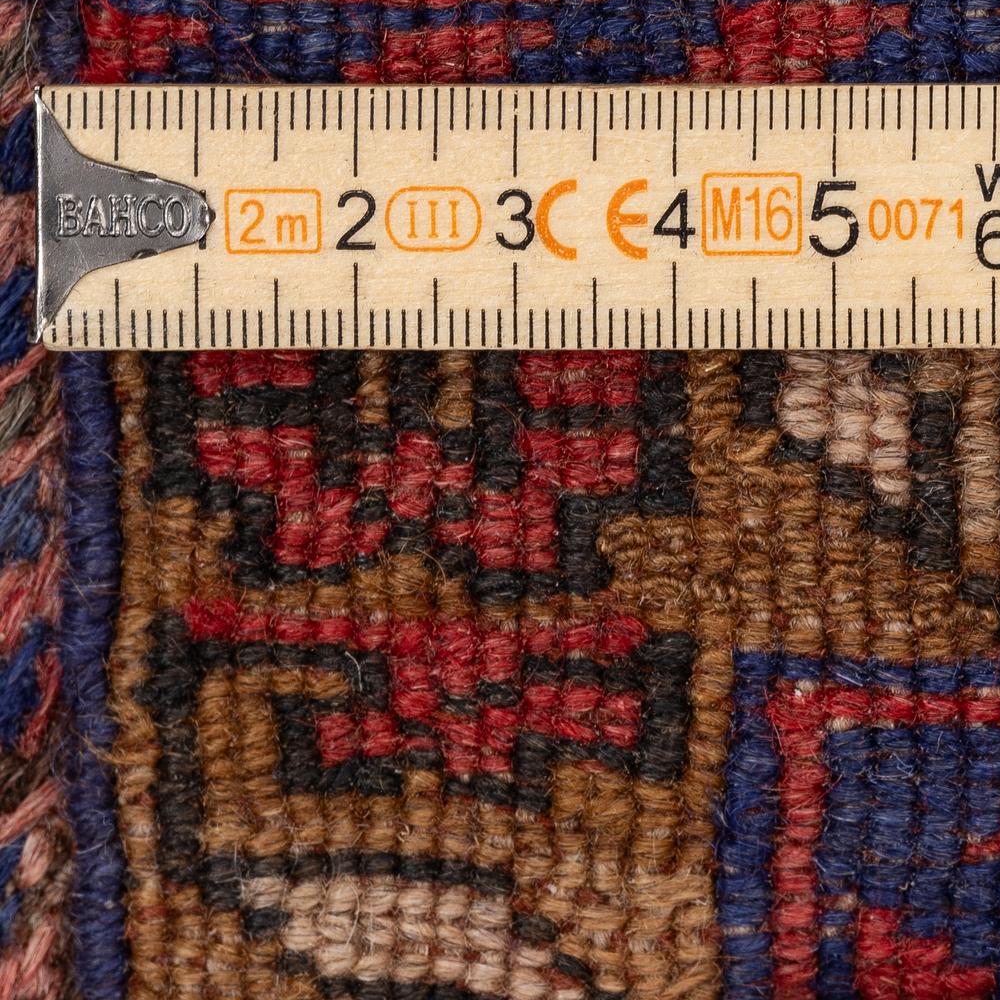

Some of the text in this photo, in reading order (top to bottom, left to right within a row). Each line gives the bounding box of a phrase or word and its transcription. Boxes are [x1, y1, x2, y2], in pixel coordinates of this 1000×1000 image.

[55, 194, 191, 239] BAHCO
[335, 189, 377, 251] 2
[495, 188, 535, 251] 3
[535, 178, 649, 262] CE
[653, 189, 696, 250] 4
[711, 185, 795, 242] M16
[809, 180, 861, 258] 5
[867, 197, 965, 242] 0071
